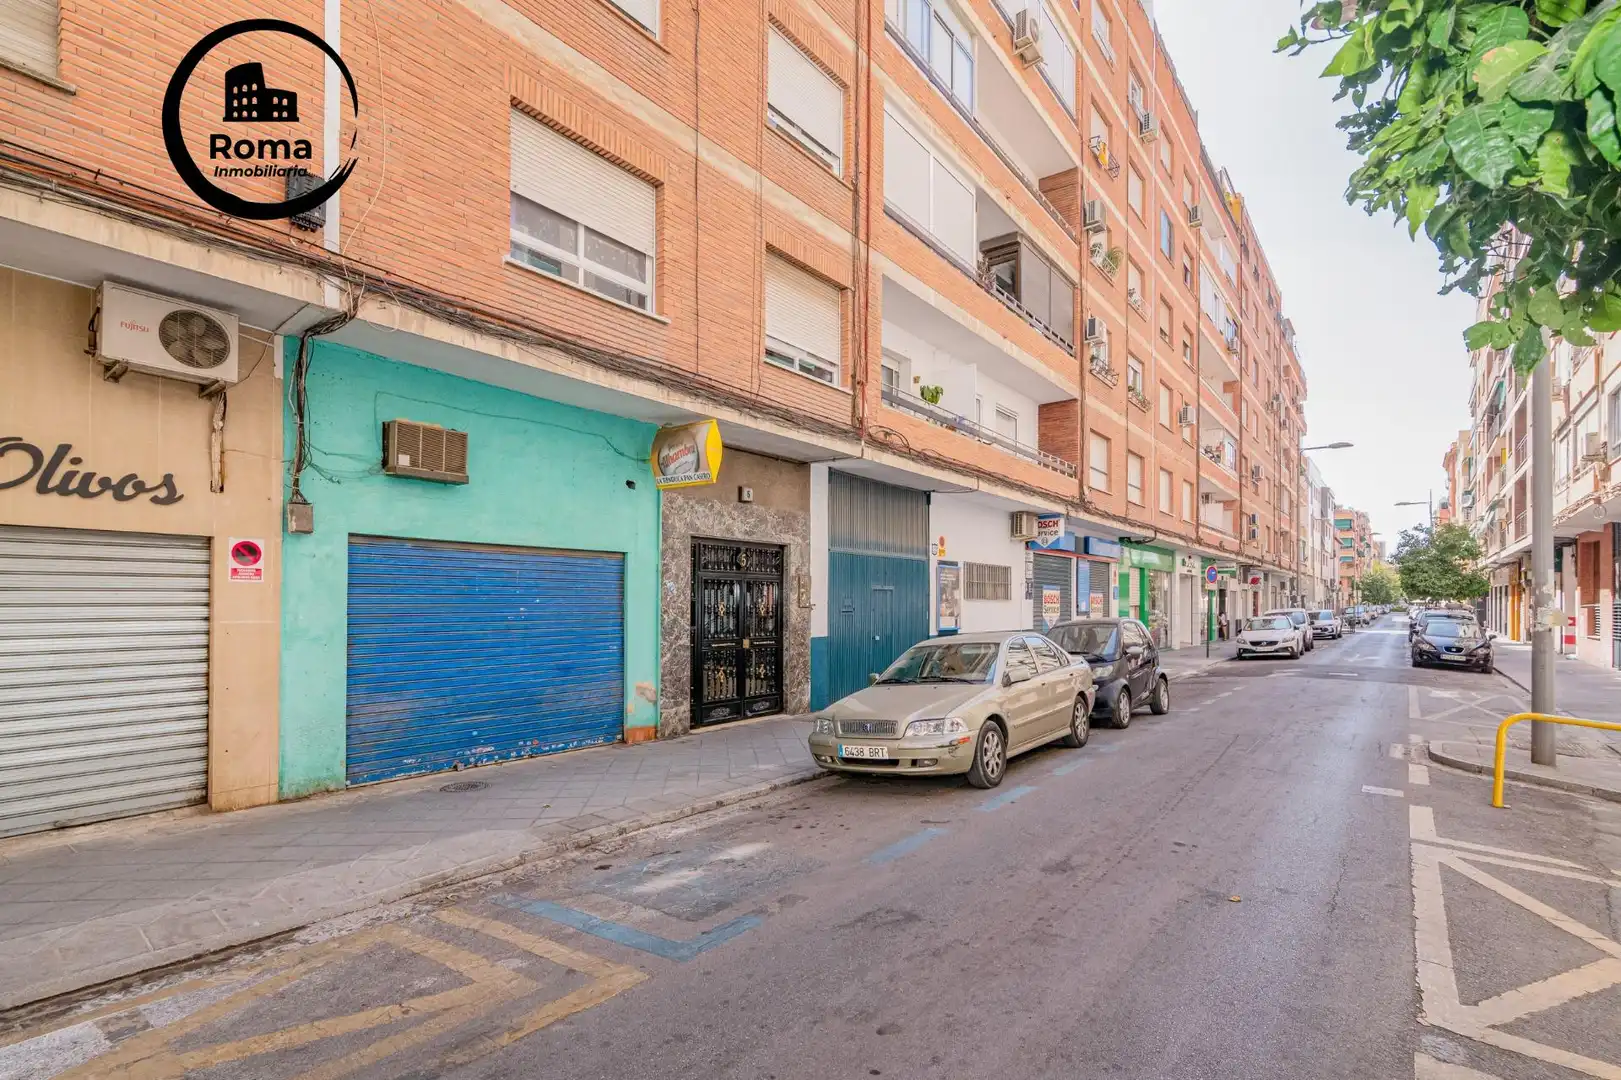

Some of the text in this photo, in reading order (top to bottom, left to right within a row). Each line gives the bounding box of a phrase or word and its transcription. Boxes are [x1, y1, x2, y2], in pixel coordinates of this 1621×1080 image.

[1037, 520, 1059, 528] OSCH
[844, 746, 886, 757] 6438 BRT
